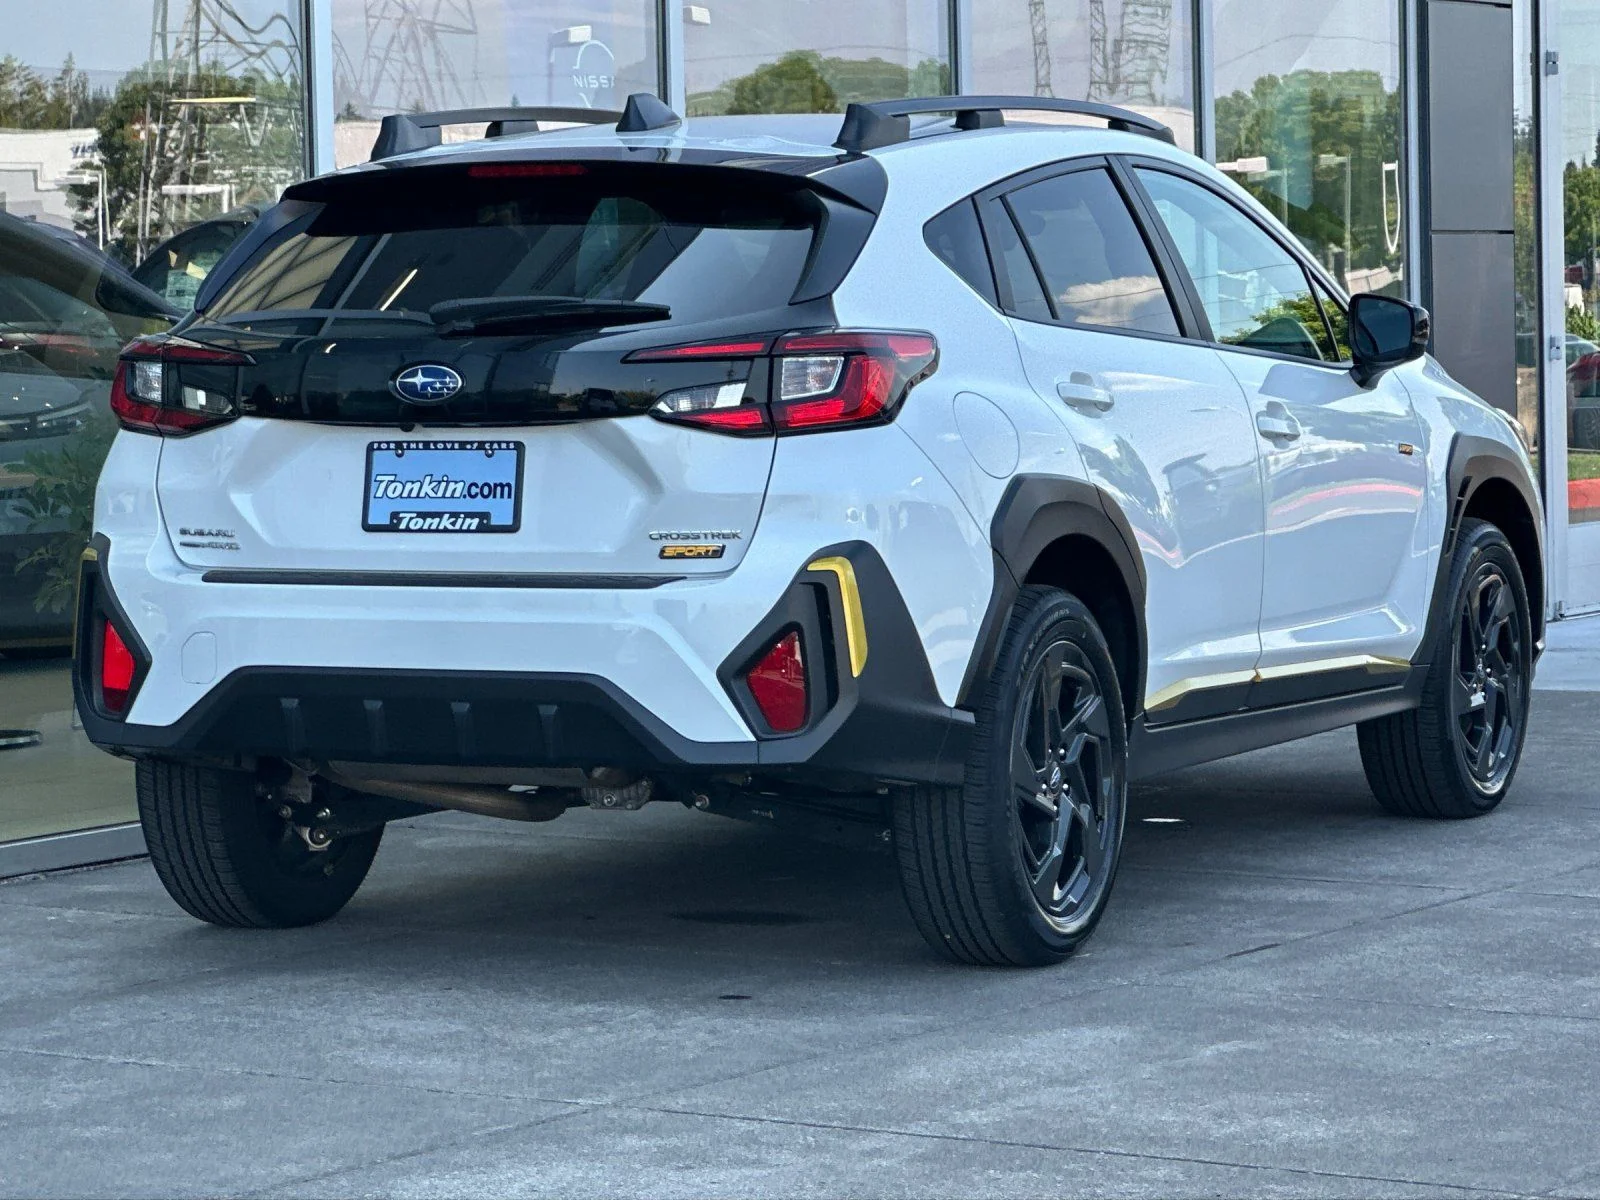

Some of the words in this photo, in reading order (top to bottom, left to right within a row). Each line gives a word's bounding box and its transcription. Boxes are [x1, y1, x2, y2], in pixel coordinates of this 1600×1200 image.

[373, 442, 396, 450] FOR
[402, 442, 424, 450] THE
[429, 442, 460, 450] LOVE
[484, 442, 515, 450] CARS
[374, 474, 513, 499] Tonkin.com
[398, 512, 480, 530] Tonkin
[648, 530, 742, 541] CROSSTREK
[663, 546, 719, 556] SPORT
